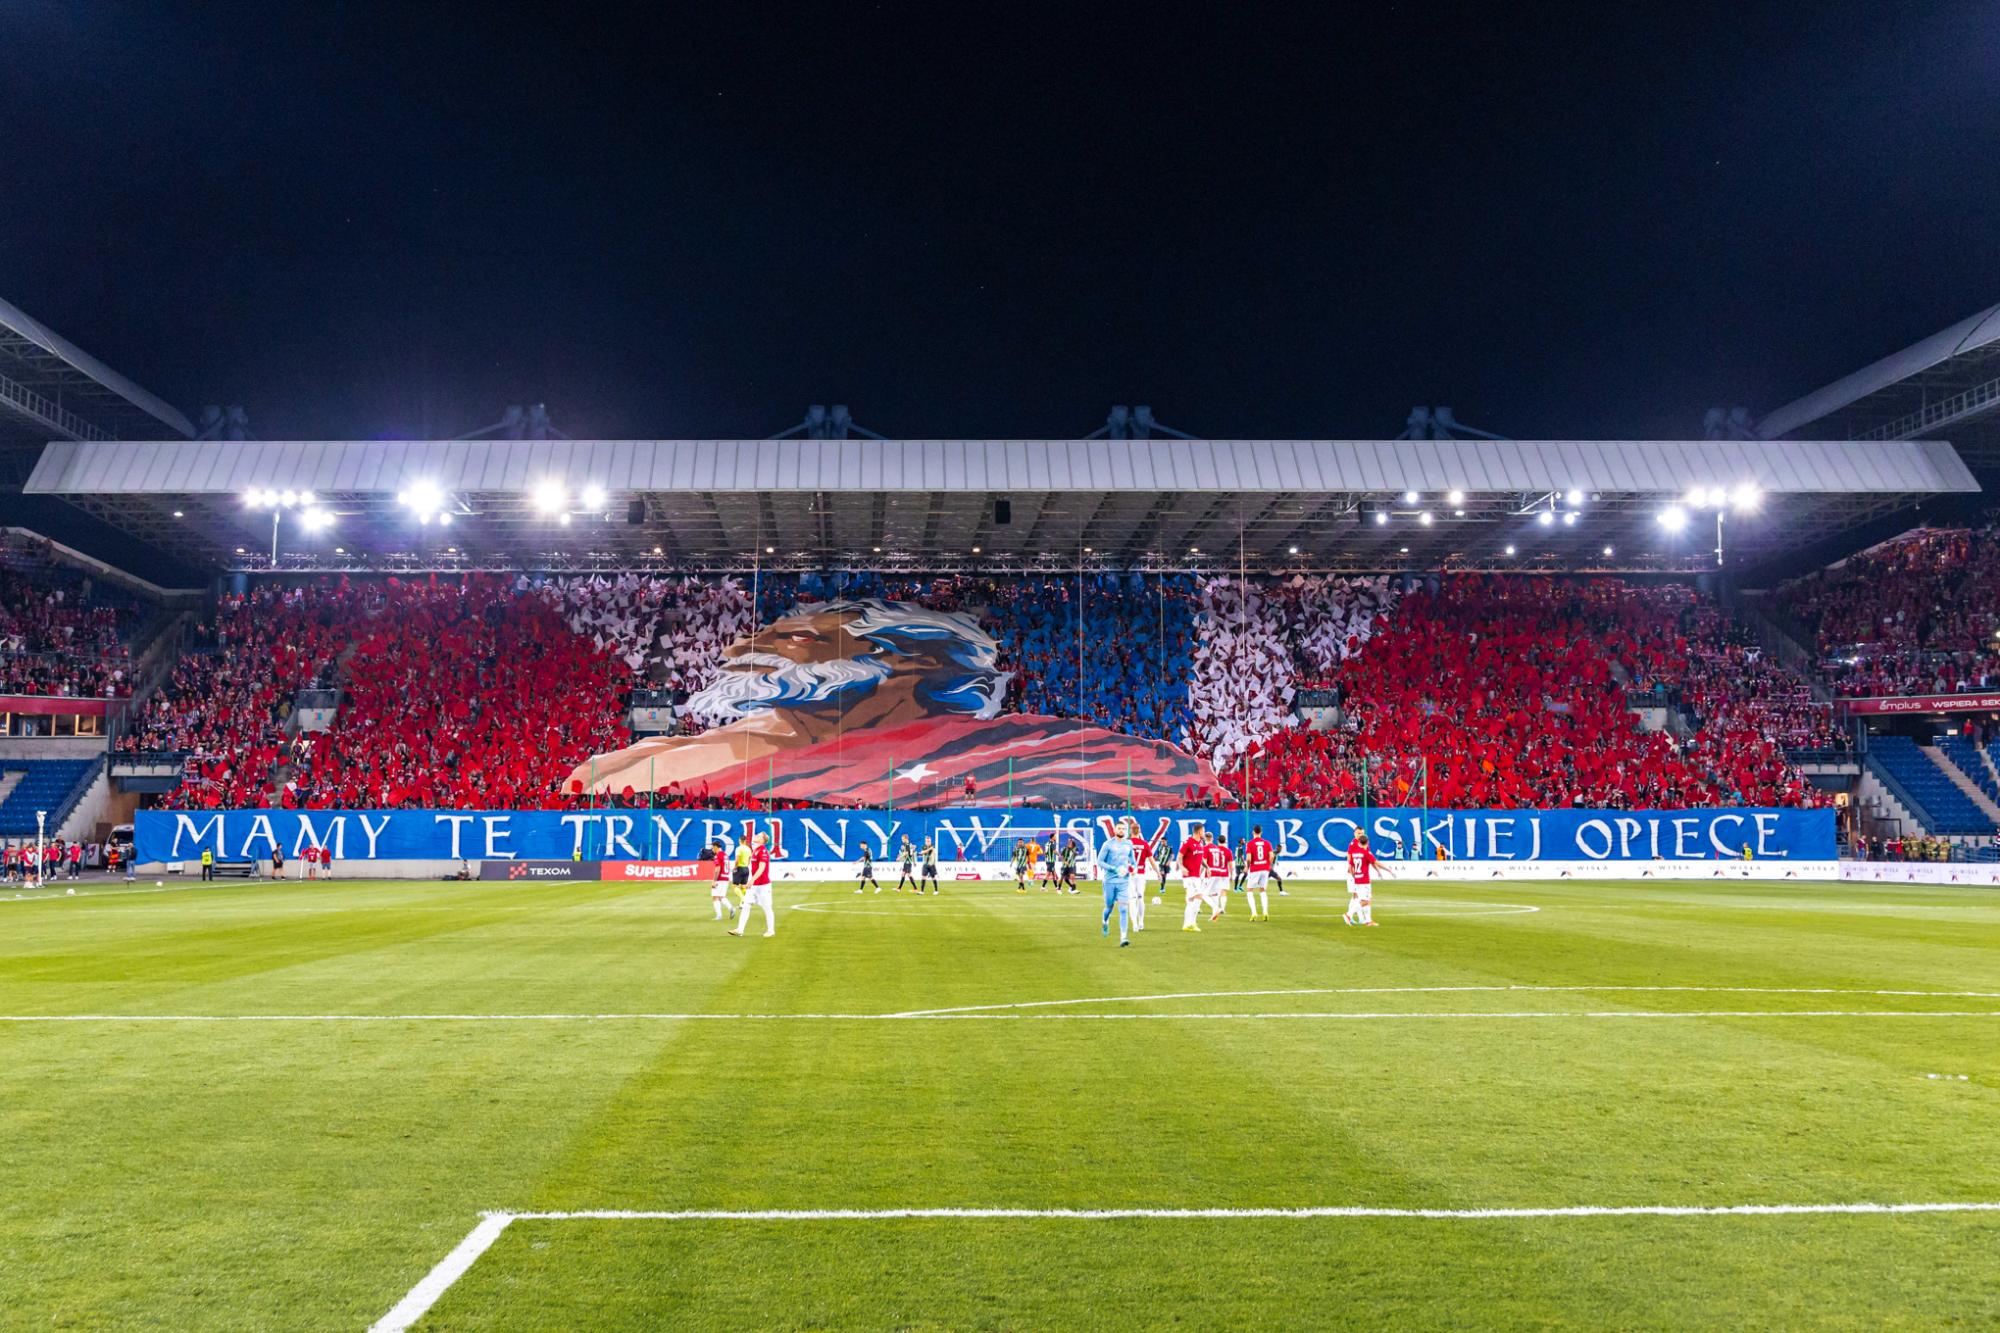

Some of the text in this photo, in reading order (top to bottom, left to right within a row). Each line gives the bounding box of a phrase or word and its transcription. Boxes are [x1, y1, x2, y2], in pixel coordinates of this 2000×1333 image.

[1932, 700, 1978, 708] WSPIERA
[171, 814, 390, 859] MAMY
[435, 815, 517, 860] TE
[940, 814, 1013, 854] W
[1275, 814, 1541, 861] BOSKIEJ
[1575, 814, 1788, 859] OPIECE
[530, 867, 571, 876] TEXOM
[625, 864, 699, 878] SUPERBET
